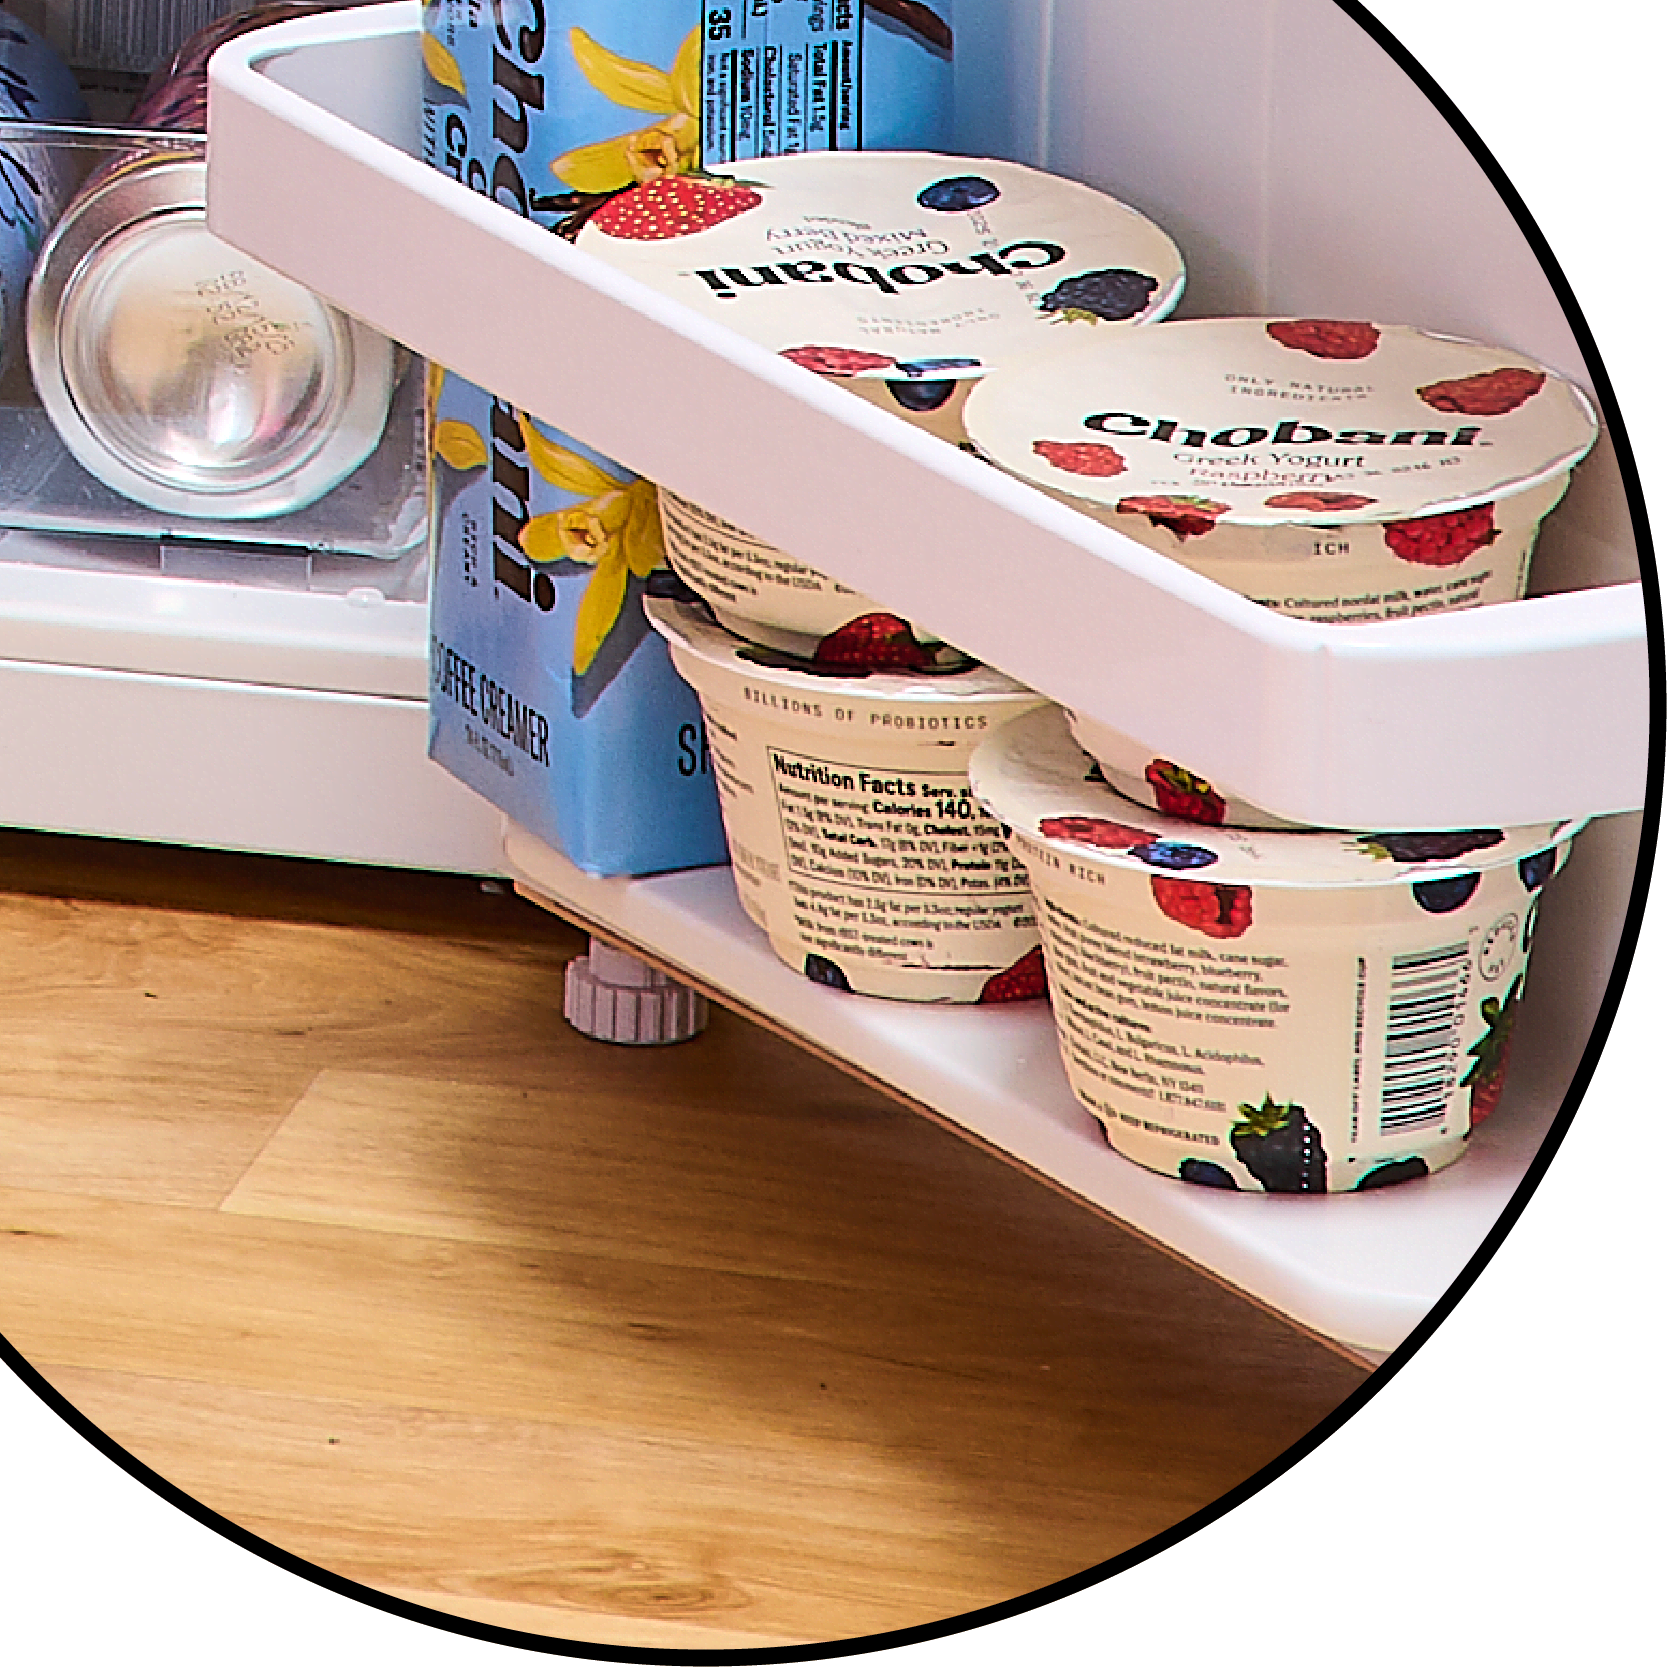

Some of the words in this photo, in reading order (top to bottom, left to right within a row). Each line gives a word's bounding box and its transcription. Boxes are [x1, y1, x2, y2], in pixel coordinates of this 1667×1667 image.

[708, 8, 732, 41] 35
[694, 241, 1066, 300] Chobani
[1083, 411, 1482, 448] Chobani
[1173, 452, 1259, 467] Greek
[1269, 451, 1365, 469] Yogurt
[479, 673, 550, 767] CREAMER
[744, 687, 823, 718] BILLIONS
[835, 708, 856, 722] OF
[870, 711, 989, 730] PROBIOTICS
[773, 753, 855, 791] Nutrition
[859, 771, 916, 797] Facts
[872, 800, 931, 818] Calories
[1068, 862, 1105, 884] RICH
[1123, 934, 1168, 953] reduced
[1170, 943, 1185, 956] fat
[1219, 953, 1248, 963] cane
[1199, 980, 1241, 995] natural
